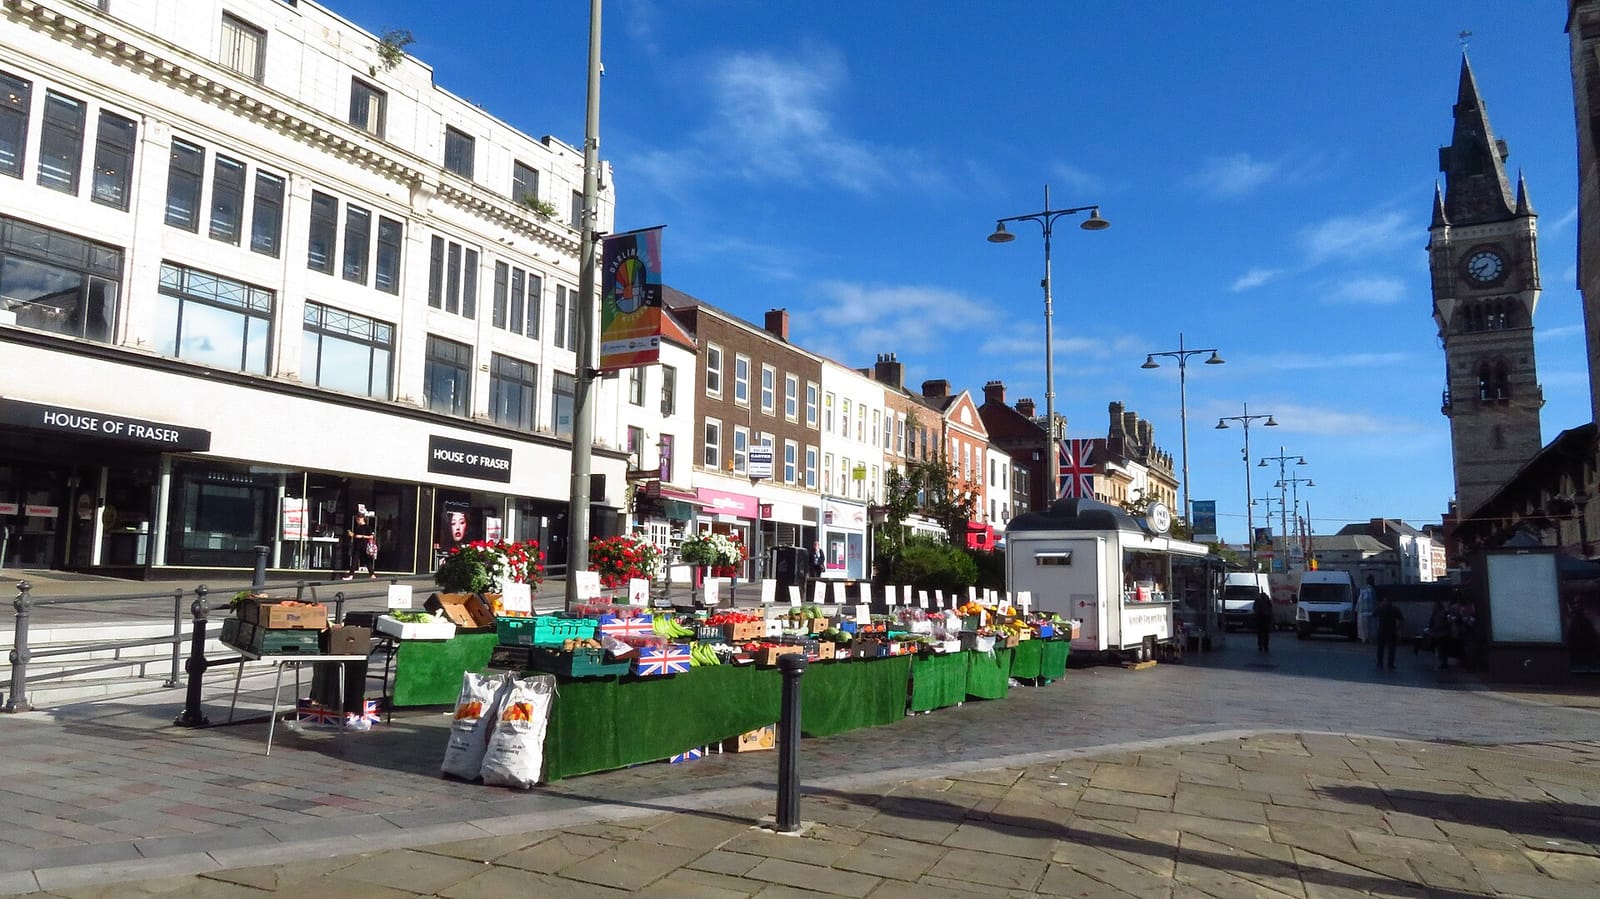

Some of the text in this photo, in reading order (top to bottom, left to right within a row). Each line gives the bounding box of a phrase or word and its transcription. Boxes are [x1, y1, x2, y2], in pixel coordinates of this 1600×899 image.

[43, 410, 180, 443] HOUSE OF FRASER
[434, 449, 509, 470] HOUSE OF FRASER
